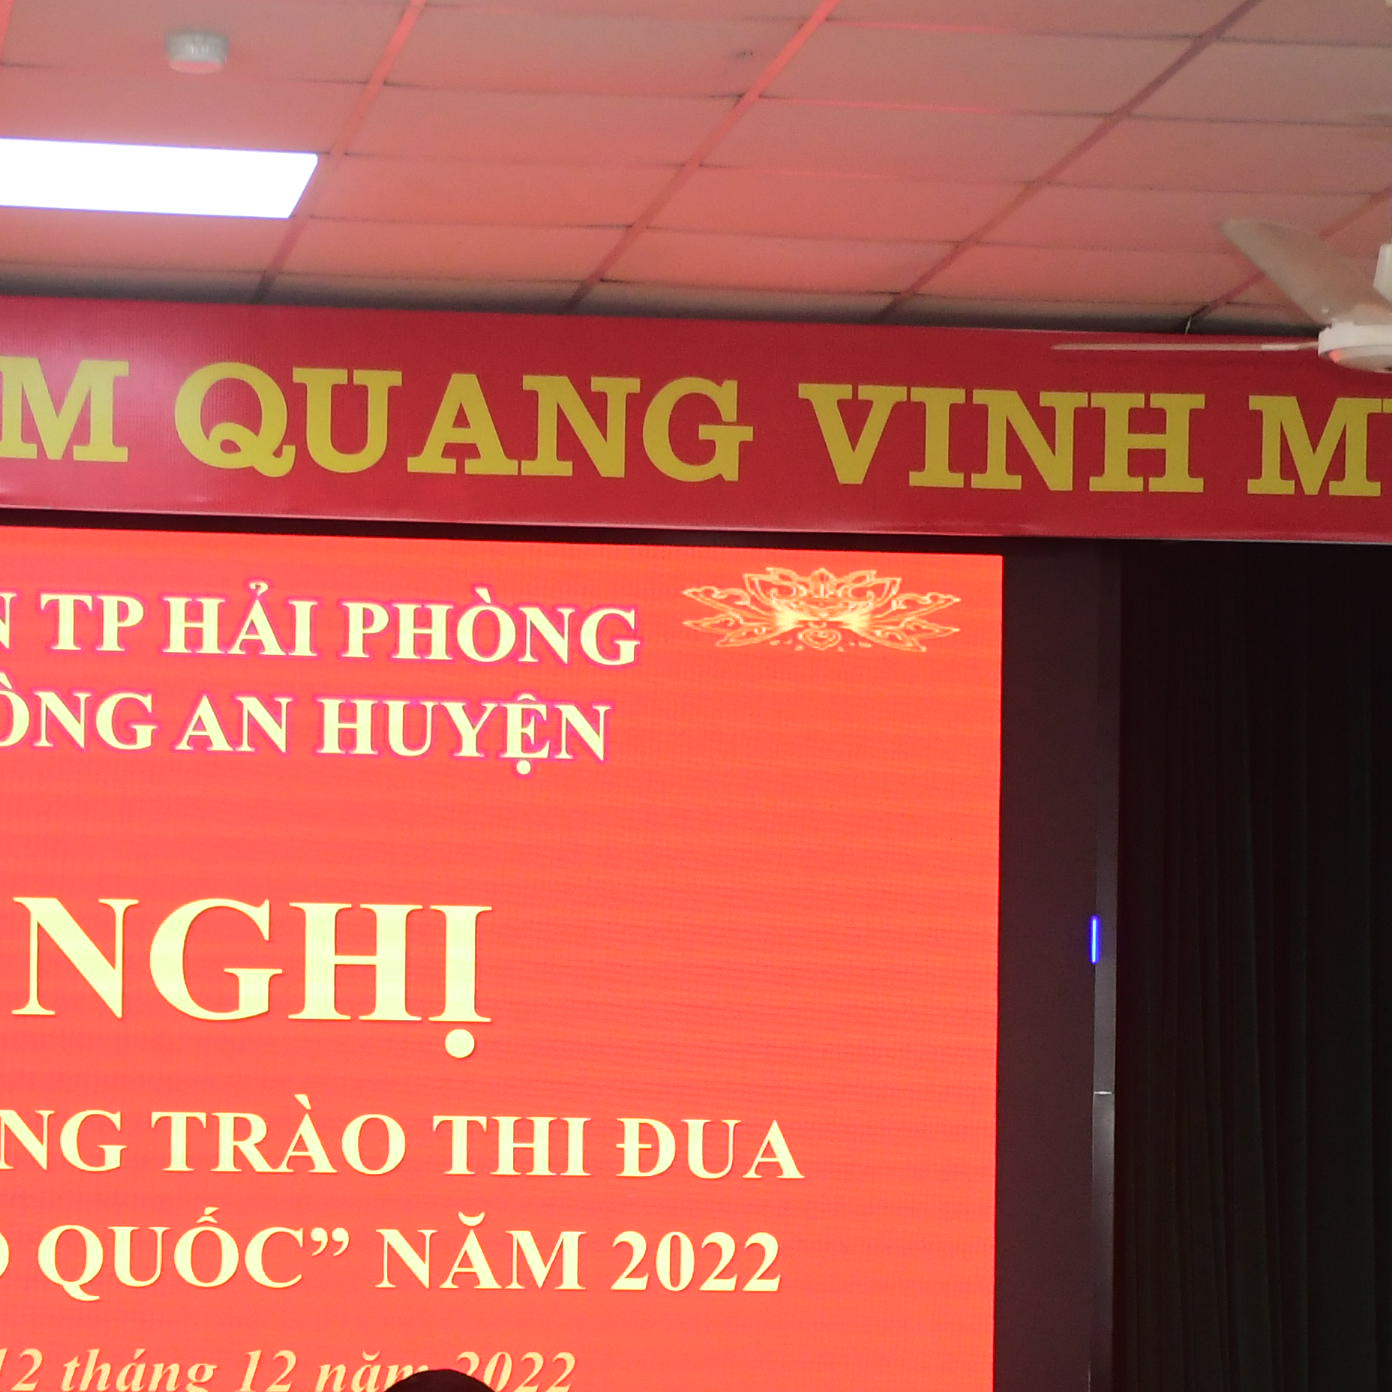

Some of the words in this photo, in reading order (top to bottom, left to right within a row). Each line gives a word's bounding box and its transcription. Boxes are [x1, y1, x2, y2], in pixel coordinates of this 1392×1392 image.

[175, 362, 754, 482] QUANG
[799, 383, 1205, 492] VINH
[40, 593, 144, 652] TP
[163, 580, 318, 657] HẢI
[342, 586, 641, 666] PHÒNG
[175, 695, 293, 753] AN
[317, 690, 611, 775] HUYỆN
[11, 896, 493, 1059] NGHỊ
[151, 1093, 406, 1175] TRÀO
[432, 1114, 591, 1177] THI
[615, 1117, 805, 1179] ĐUA
[37, 1206, 350, 1302] QUỐC”
[375, 1211, 587, 1290] NĂM
[610, 1230, 781, 1292] 2022
[238, 1349, 297, 1392] 12
